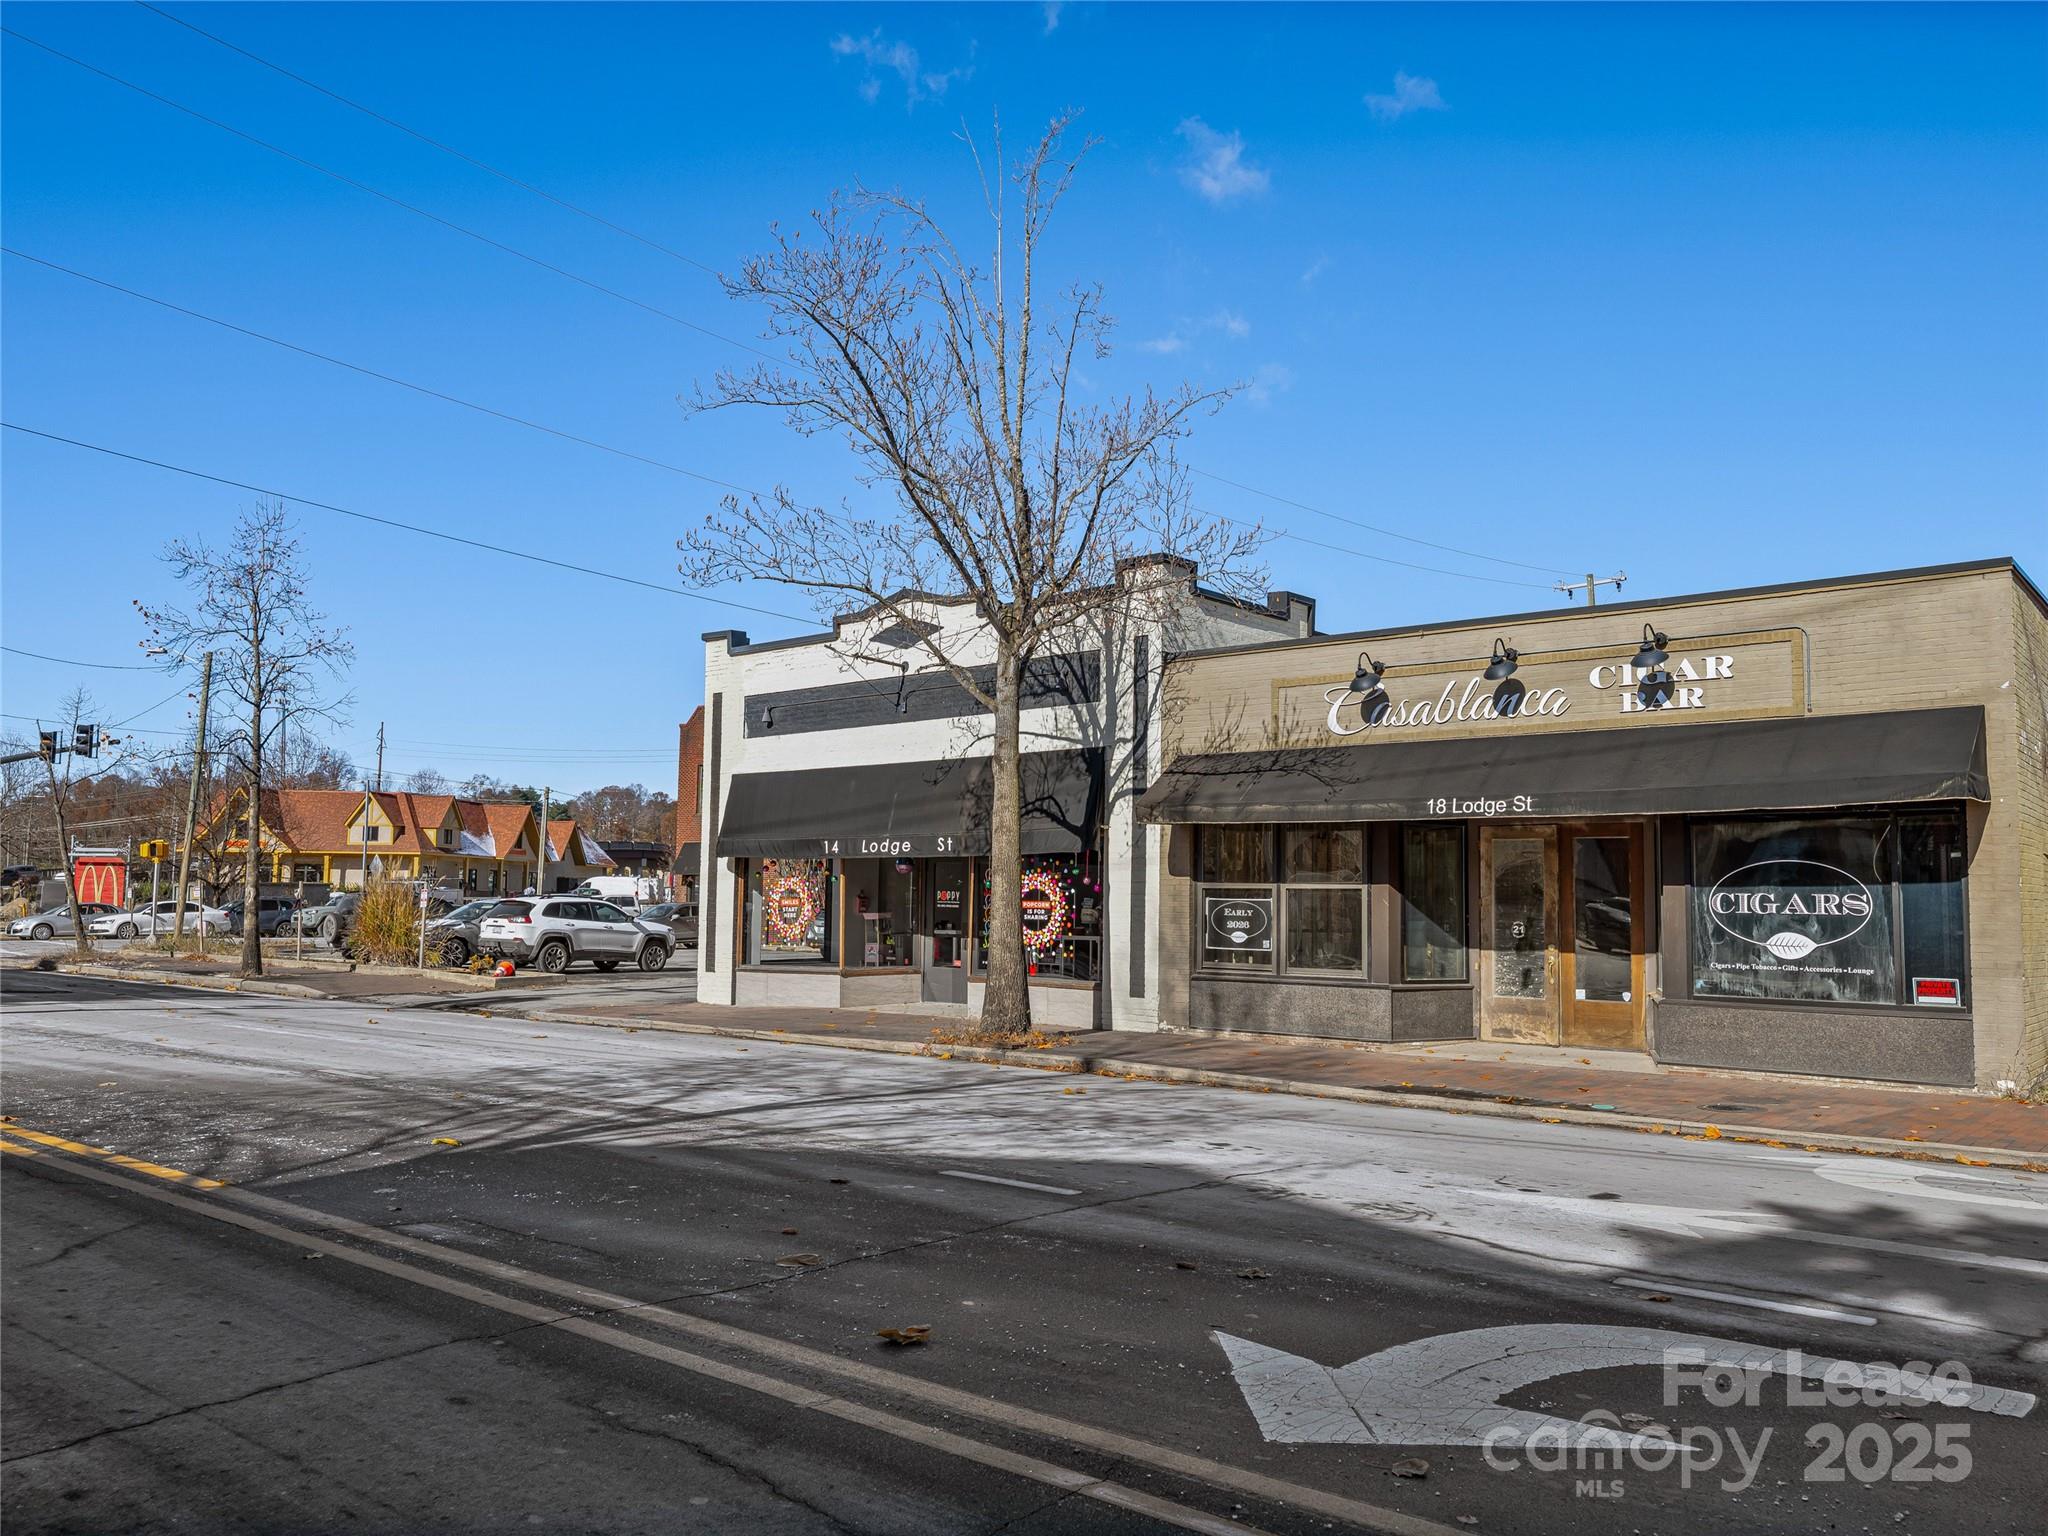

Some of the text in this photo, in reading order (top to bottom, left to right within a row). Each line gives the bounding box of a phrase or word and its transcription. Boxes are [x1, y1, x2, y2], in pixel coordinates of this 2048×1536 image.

[1589, 655, 1735, 689] CIGAR
[1323, 676, 1572, 736] Casablanca
[1619, 687, 1705, 713] BAR
[1427, 795, 1533, 817] 18 Lodge St
[823, 837, 953, 855] 14 Lodge St
[1711, 892, 1870, 917] CIGARS
[1513, 925, 1524, 934] 21
[1710, 962, 1875, 975] Cigars Pipe Tobacco Gifts Accessories Lounge
